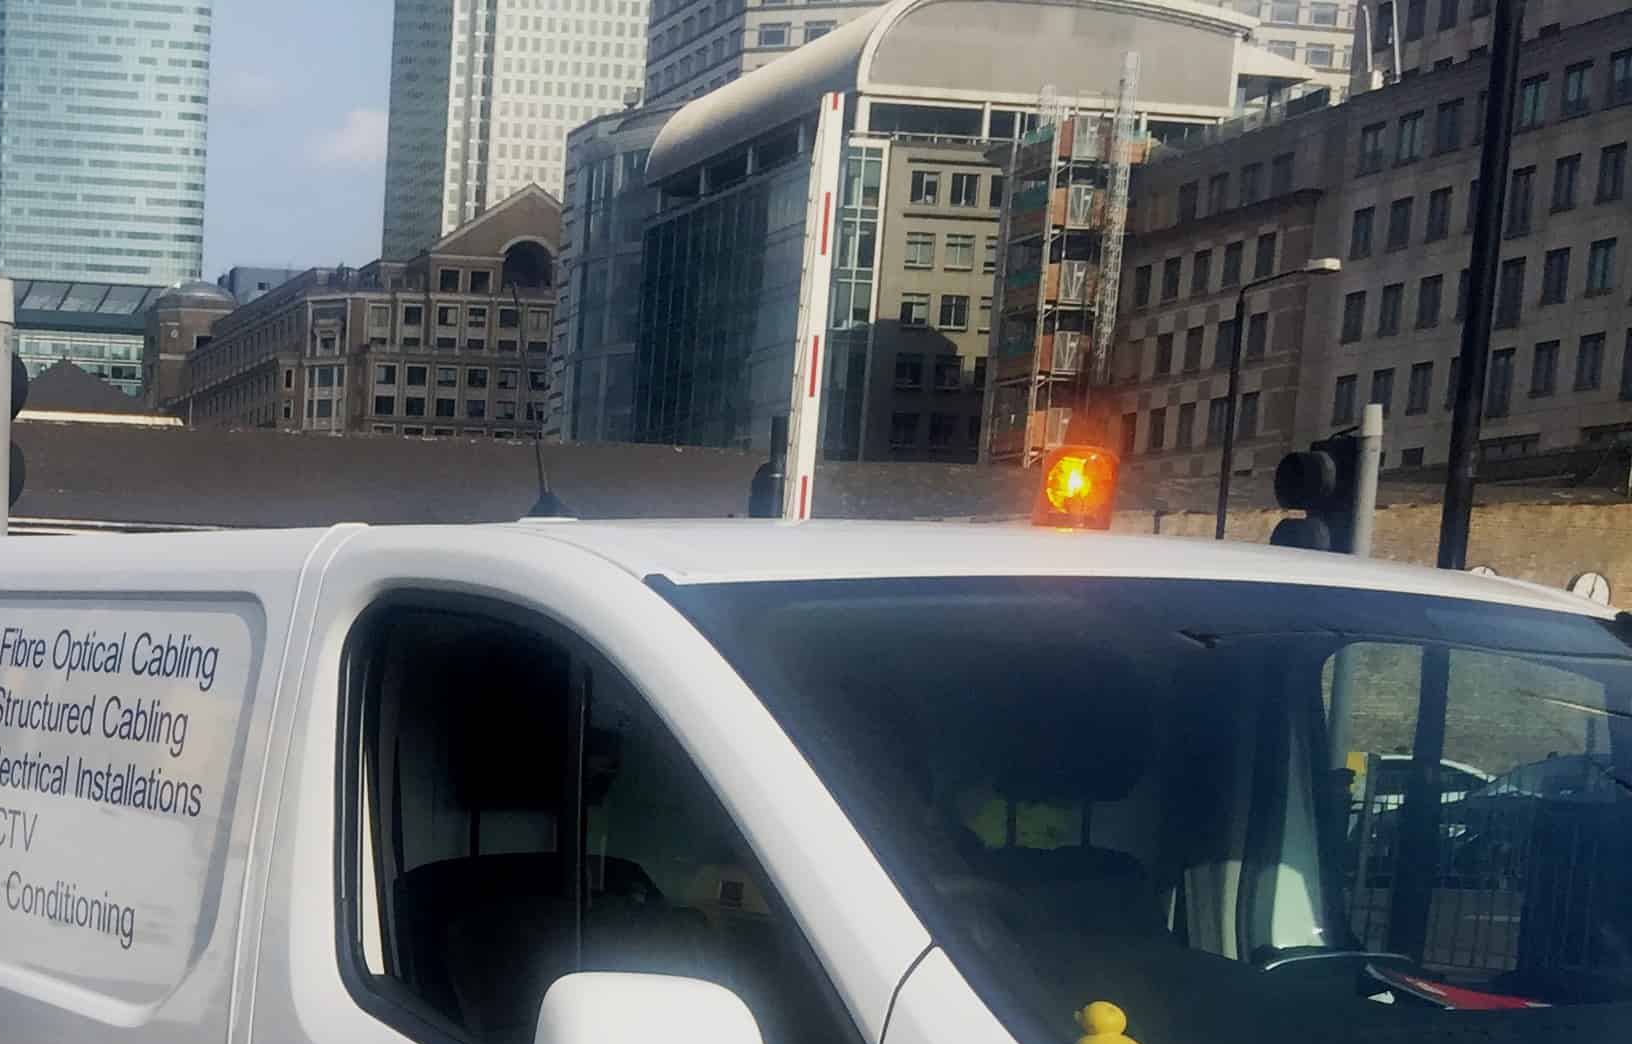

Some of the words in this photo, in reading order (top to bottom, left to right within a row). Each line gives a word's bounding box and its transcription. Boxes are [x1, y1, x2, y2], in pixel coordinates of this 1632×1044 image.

[0, 627, 46, 670] Fibre
[52, 630, 125, 680] Optical
[131, 634, 219, 692] Cabling
[102, 696, 189, 757] Cabling
[74, 753, 203, 817] Installations
[5, 870, 136, 948] Conditioning
